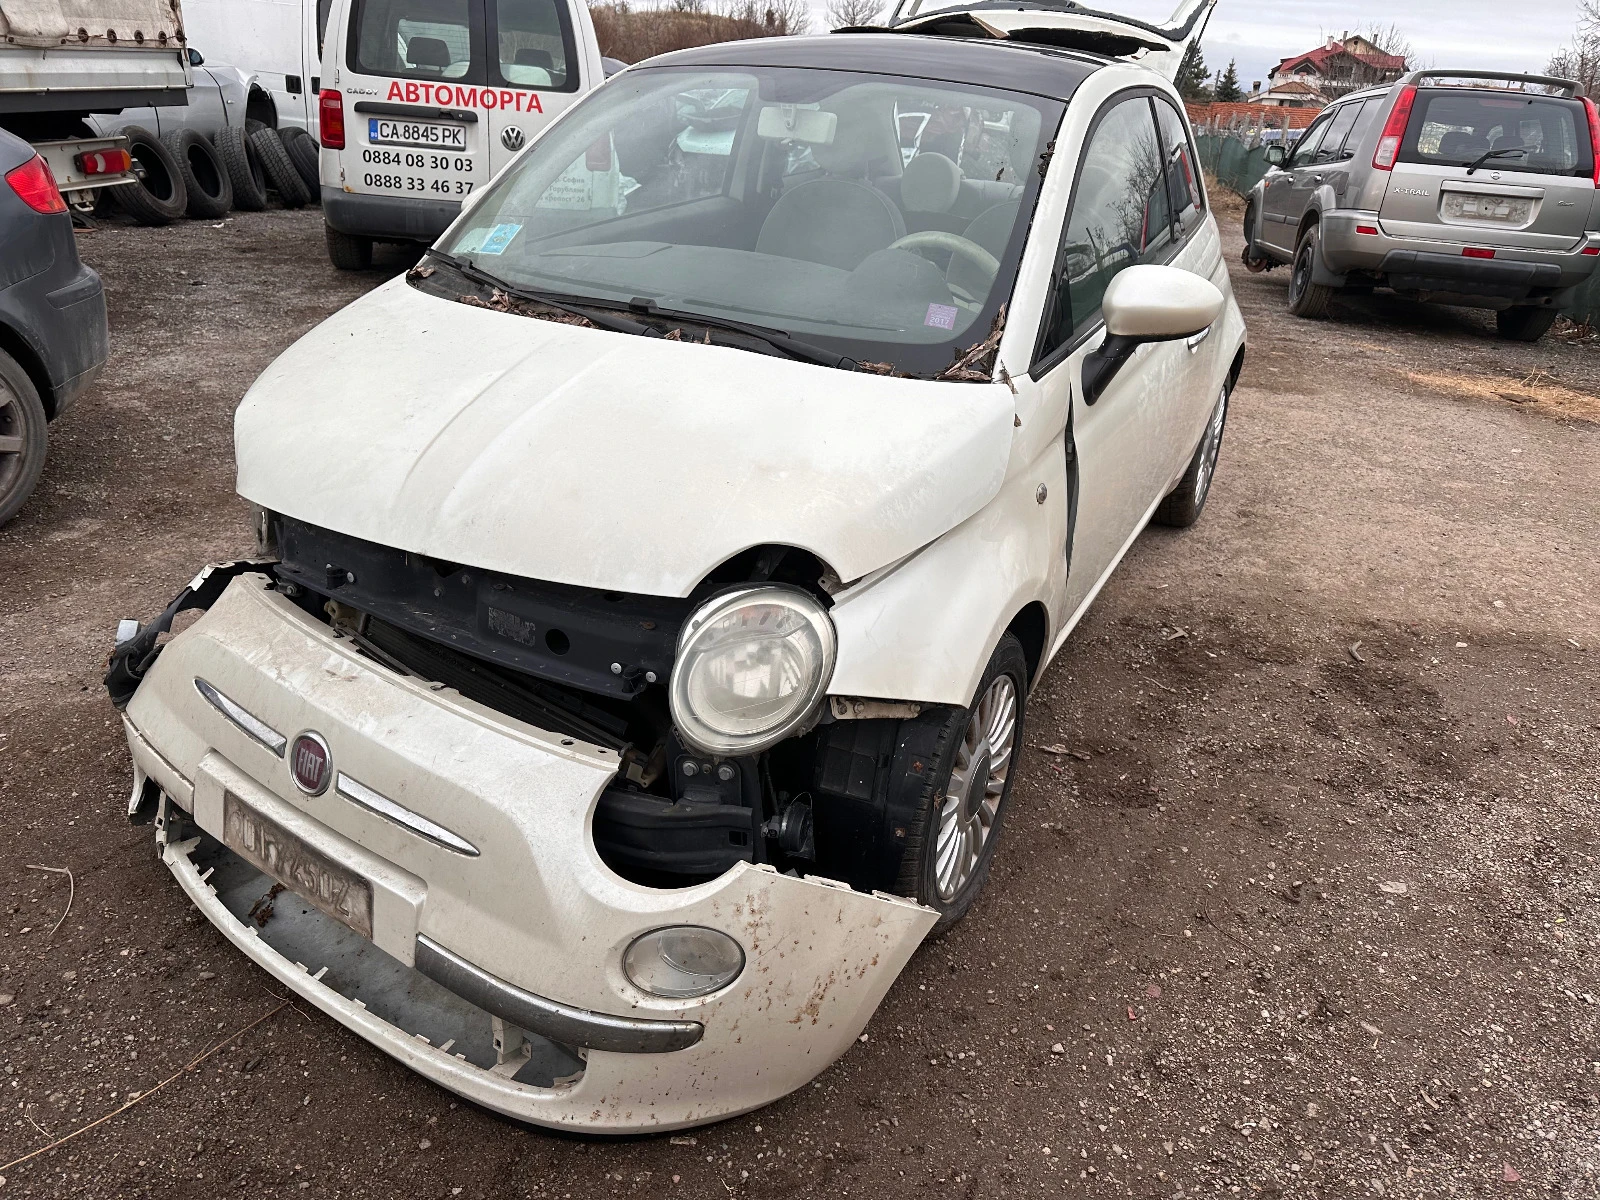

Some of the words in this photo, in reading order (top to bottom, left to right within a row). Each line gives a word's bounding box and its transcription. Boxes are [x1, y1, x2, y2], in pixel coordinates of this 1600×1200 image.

[346, 87, 379, 96] CADDY
[387, 81, 544, 114] АВТОМОРГА
[379, 122, 400, 140] CA
[402, 125, 439, 142] 8845
[442, 128, 462, 145] PK
[362, 149, 402, 166] 0884
[405, 153, 425, 168] 08
[430, 156, 449, 170] 30
[454, 158, 473, 172] 03
[364, 173, 402, 189] 0888
[406, 177, 425, 191] 33
[430, 179, 450, 194] 46
[455, 181, 474, 195] 37
[1393, 187, 1430, 196] X-TRAIL
[929, 316, 950, 325] 2017
[297, 747, 324, 783] FIAT
